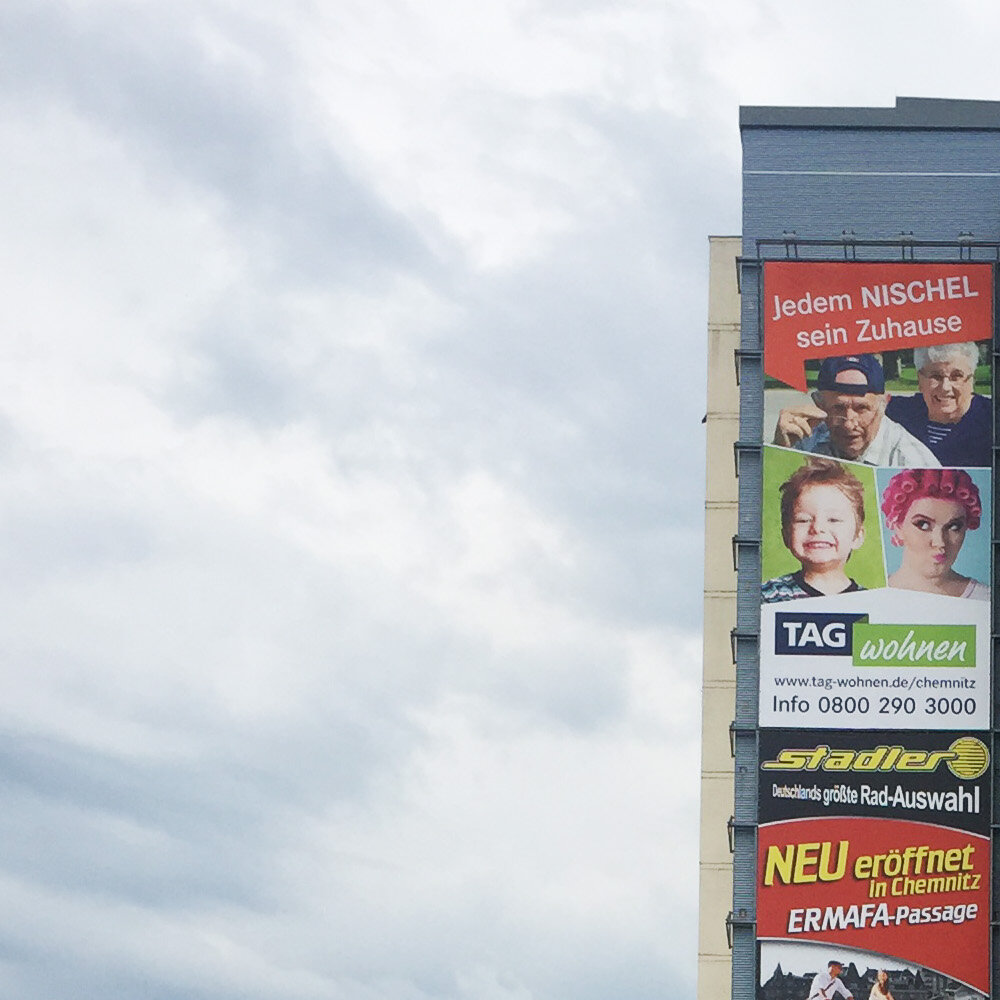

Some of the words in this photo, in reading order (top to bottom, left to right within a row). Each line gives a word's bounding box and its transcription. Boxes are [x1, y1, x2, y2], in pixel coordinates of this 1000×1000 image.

[772, 292, 852, 320] Jedem
[861, 276, 979, 309] NISCHEL
[796, 324, 848, 348] sein
[856, 316, 963, 342] Zuhause
[783, 622, 846, 648] TAG
[859, 630, 967, 662] wohnen
[774, 676, 976, 691] www.tag-wohnen.de/chemnitz
[773, 695, 810, 713] Info
[818, 696, 869, 714] 0800
[879, 697, 916, 714] 290
[925, 697, 976, 715] 3000
[761, 744, 959, 772] stadler
[772, 784, 821, 801] Deutschlands
[823, 784, 858, 805] größte
[860, 785, 980, 813] Rad-Auswahl
[764, 840, 849, 886] NEU
[854, 843, 975, 879] eröffnet
[869, 879, 887, 898] in
[891, 873, 981, 896] Chemnitz
[787, 903, 978, 933] ERMAFA-Passage
